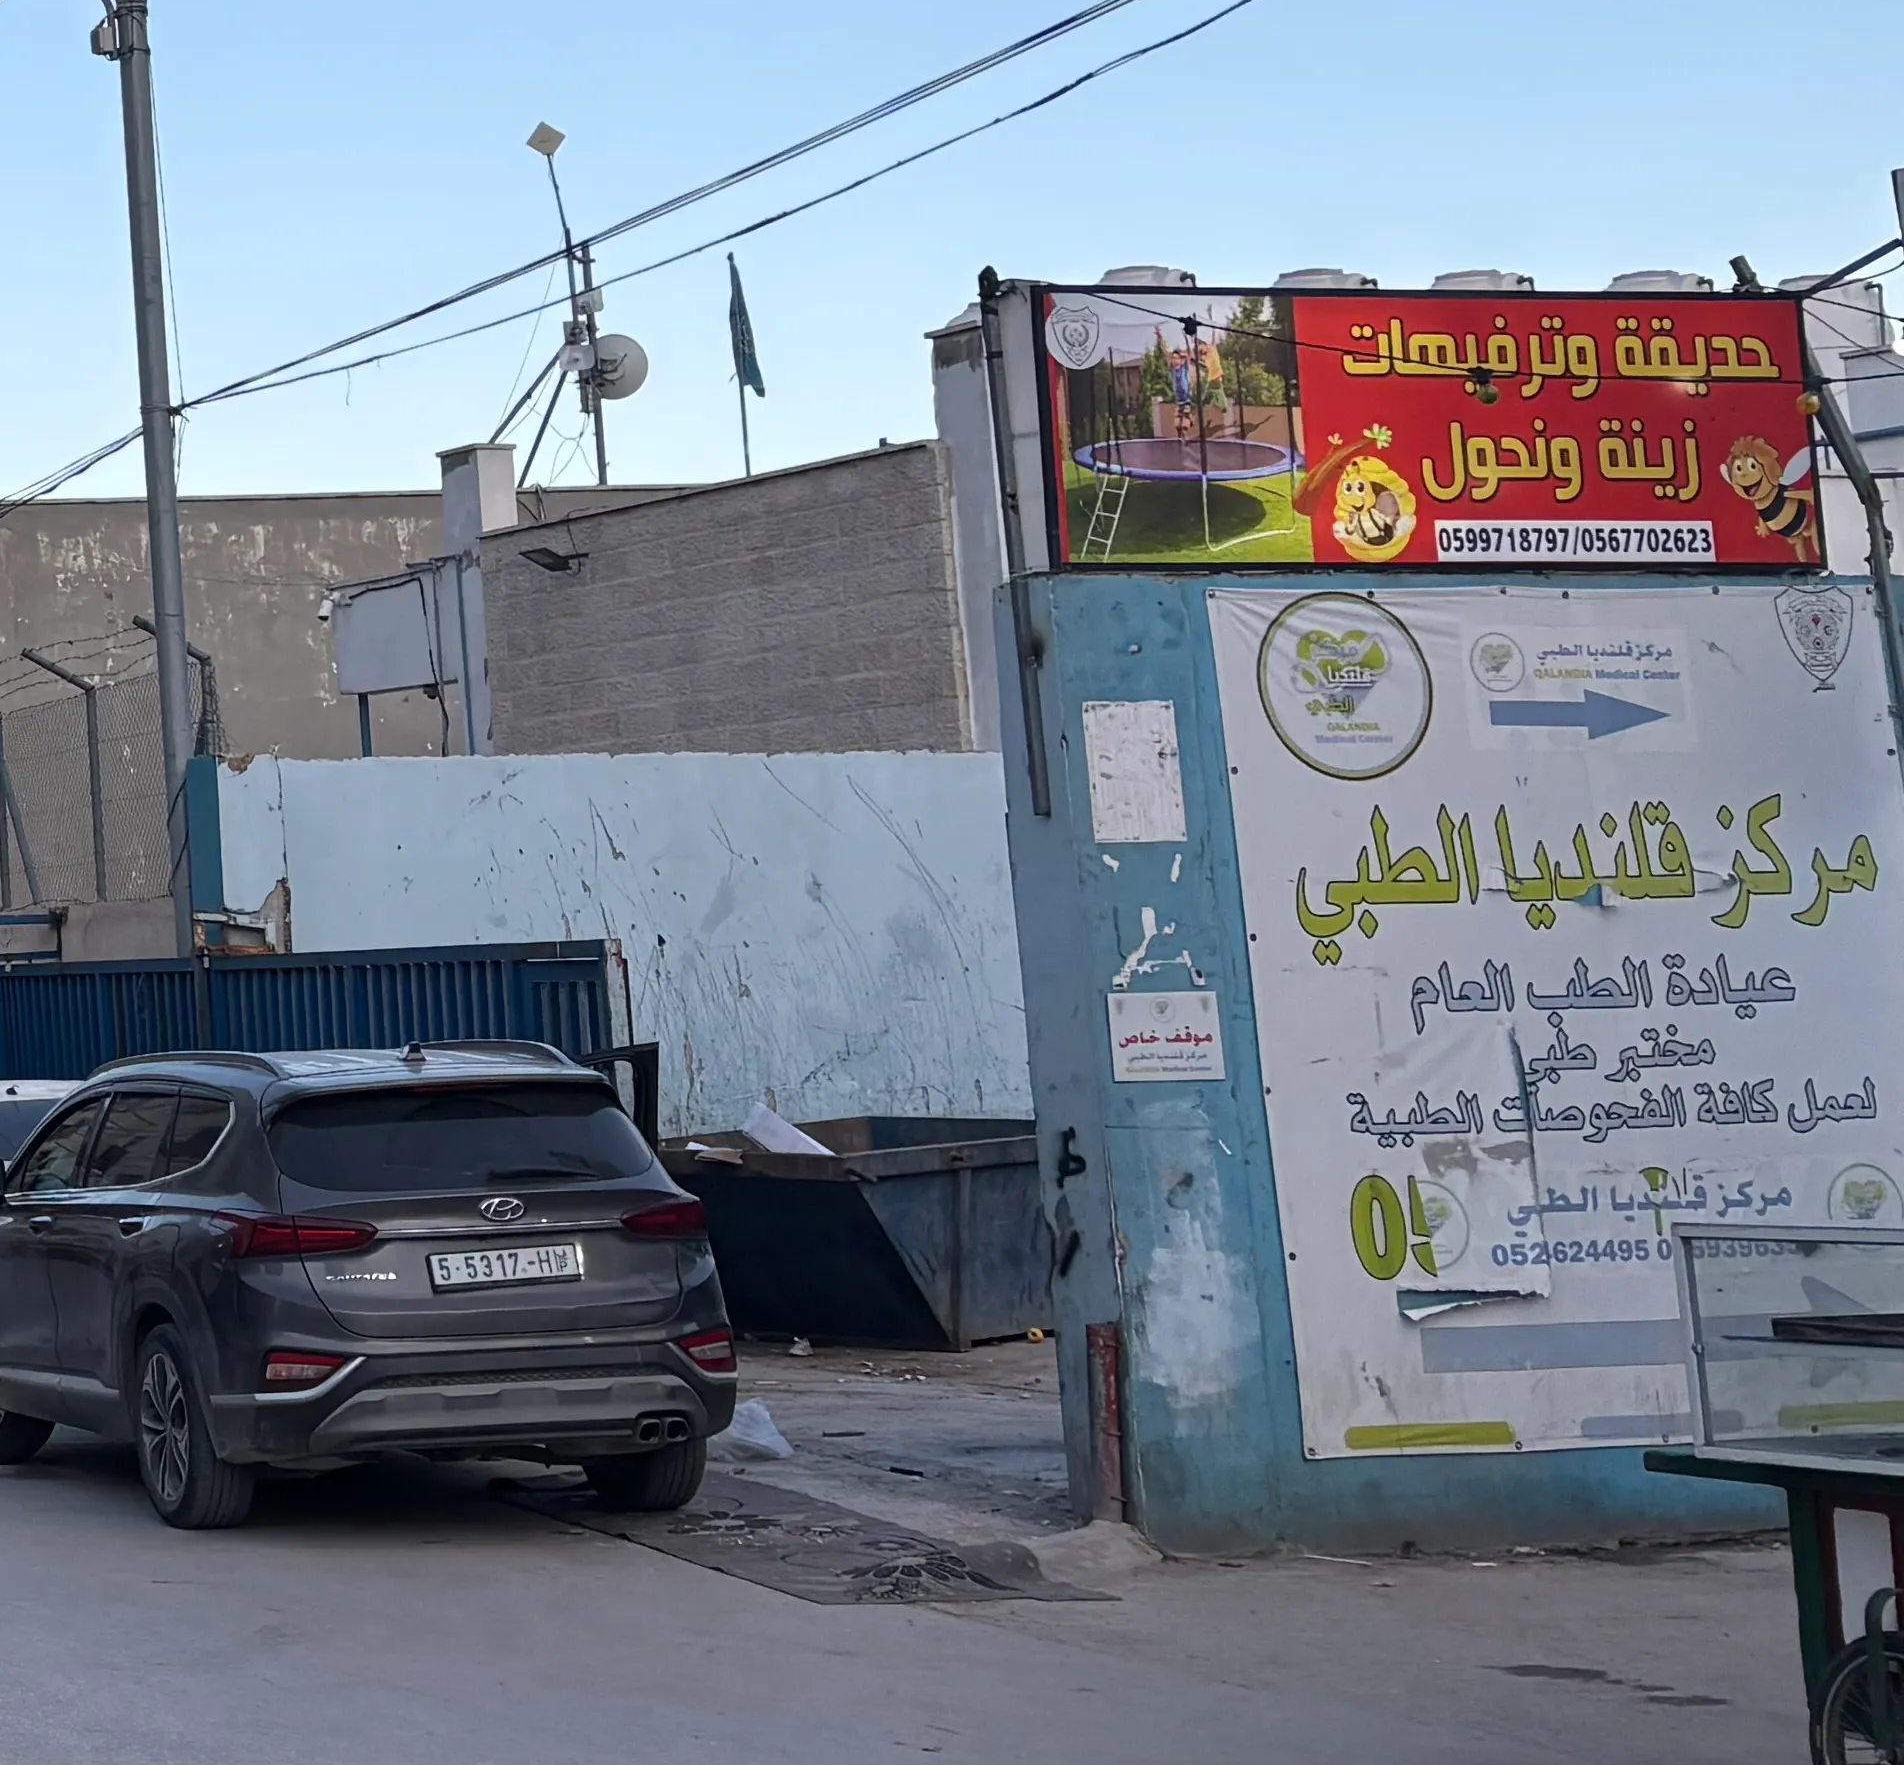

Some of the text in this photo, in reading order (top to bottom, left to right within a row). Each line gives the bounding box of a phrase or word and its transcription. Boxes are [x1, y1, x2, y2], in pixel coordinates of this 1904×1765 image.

[1341, 315, 1781, 400] حديقة وترفيهات
[1421, 417, 1701, 503] زينة ونحول
[1438, 526, 1713, 554] 0599718797/0567702623
[1536, 640, 1672, 666] مركز قلنديا الطبي
[1595, 668, 1640, 680] Medical
[1642, 669, 1680, 680] Center
[1295, 794, 1879, 966] مركز قلنديا الطبي
[1411, 953, 1796, 1035] عيادة الطب العام
[1118, 1025, 1214, 1048] موقف خاص
[1524, 1024, 1716, 1084] مختبر طبي
[1346, 1077, 1877, 1150] لعمل كافة الفحوصات الطبية
[1507, 1173, 1792, 1238] مركز قديا الطي
